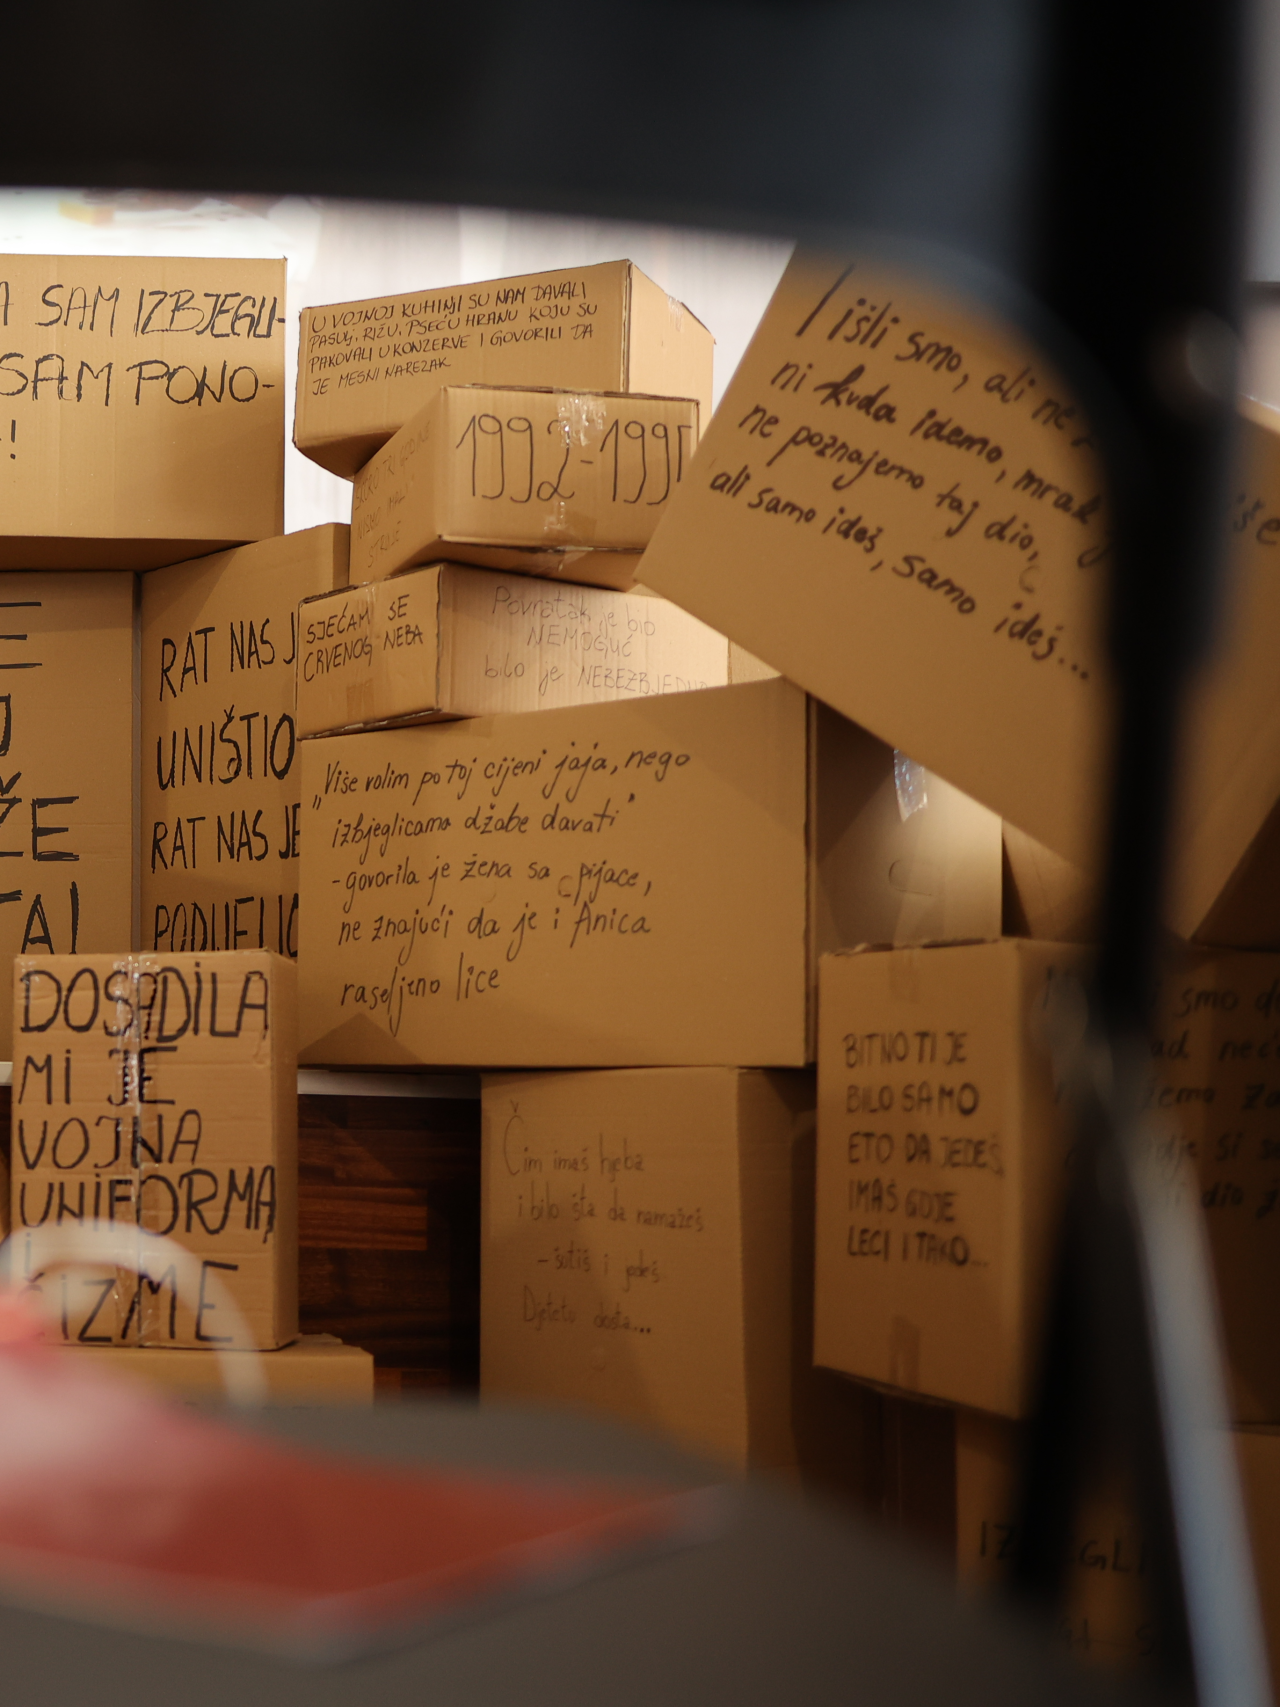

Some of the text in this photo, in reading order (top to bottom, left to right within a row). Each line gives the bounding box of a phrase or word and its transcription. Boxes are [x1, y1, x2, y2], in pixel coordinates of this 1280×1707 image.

[35, 284, 120, 337] SAM
[312, 281, 587, 333] U VOJNOJ SU NAM DAVALI
[407, 303, 598, 337] PSEĆU HRANU KOJU SU
[309, 323, 594, 373] PAKOVALI KONZERVE GOVORILI DA
[312, 358, 452, 396] JE MESNI NAREZAK
[827, 298, 1036, 402] išli smo, ali
[771, 360, 1008, 482] ni idemo,
[738, 402, 1040, 561] ne poznajemo taj dio,
[708, 465, 976, 616] ali samo ideš, samo
[306, 594, 410, 644] SJEĆAM SE
[492, 585, 656, 638] Povratak je bio
[526, 624, 632, 659] NEMOGUĆ
[159, 618, 275, 701] RAT NAS
[303, 627, 423, 682] CRVENOG NEBA
[484, 655, 564, 696] bilo je
[156, 704, 296, 791] UNIŠTIO
[365, 742, 690, 805] volim po toj cijeni jaja, nego
[150, 803, 300, 873] RAT NAS JE
[332, 803, 529, 864] izbjeglicama džabe
[428, 854, 550, 906] je žena sa
[339, 900, 650, 965] ne znajući da je Anica
[340, 951, 500, 1036] raseljeno lice
[107, 1045, 177, 1105] JE
[18, 1109, 201, 1170] VOJNA
